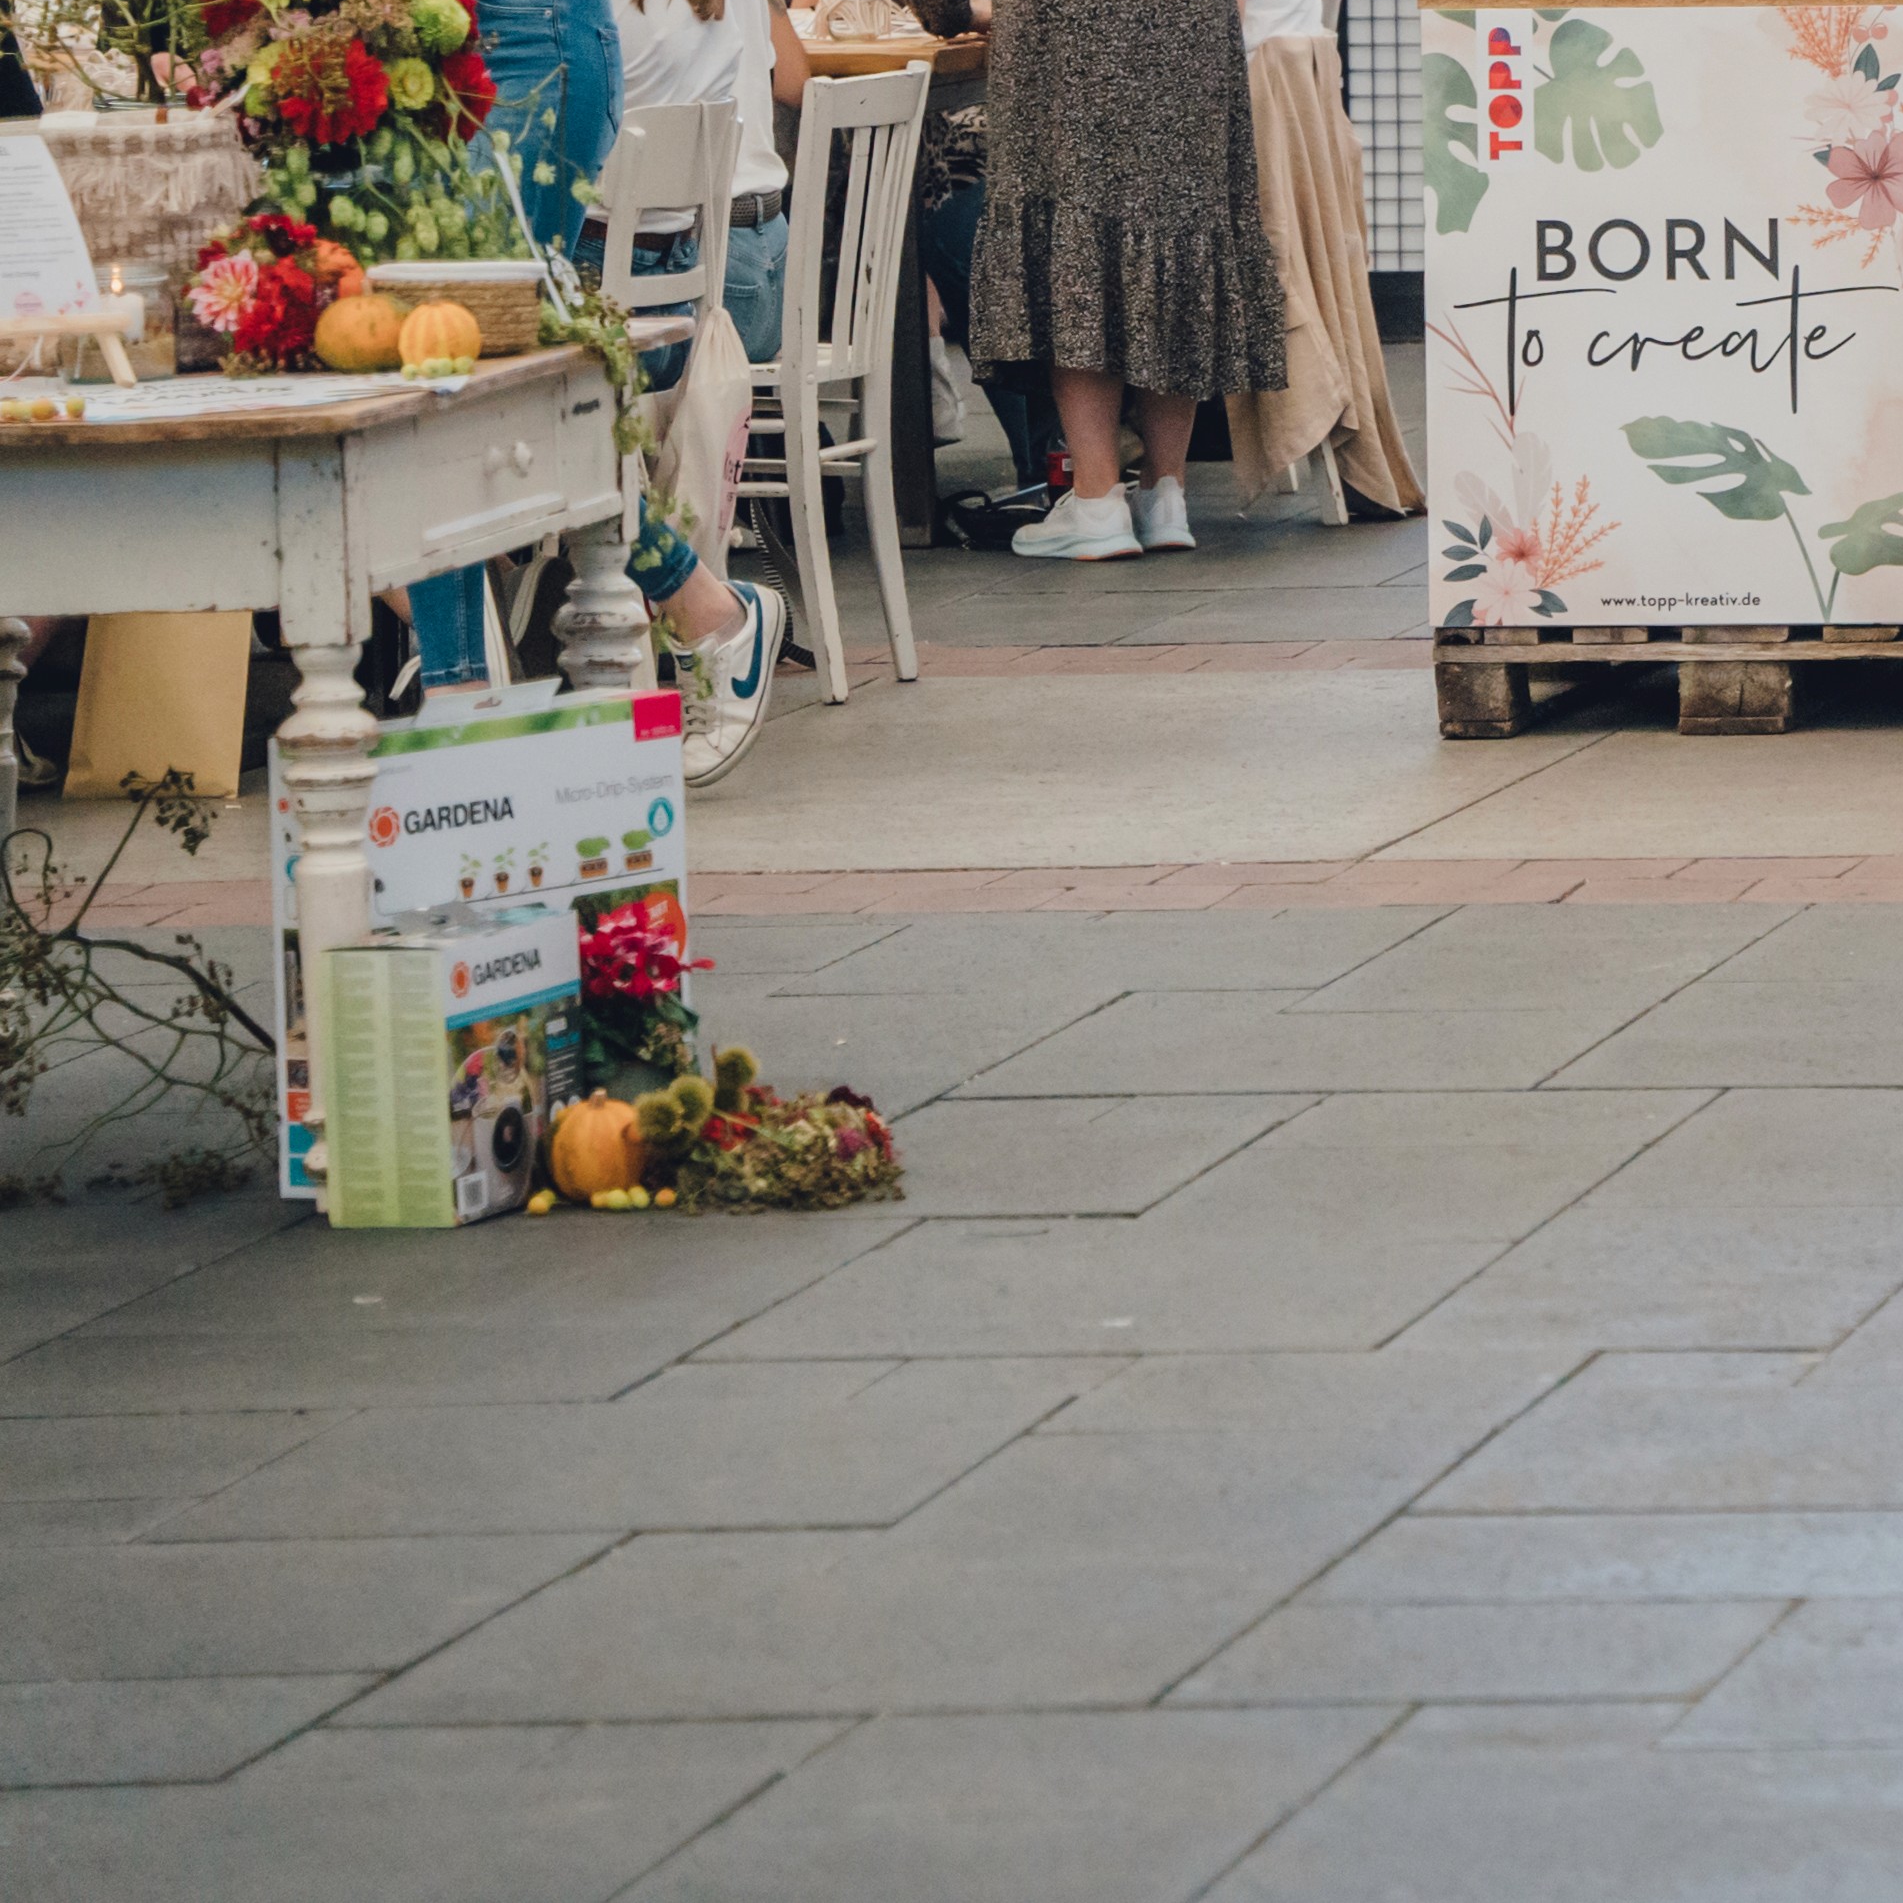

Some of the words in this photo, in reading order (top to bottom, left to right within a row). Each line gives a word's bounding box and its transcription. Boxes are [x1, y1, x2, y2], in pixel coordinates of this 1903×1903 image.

[1488, 26, 1525, 160] TOPP
[1534, 217, 1781, 283] BORN
[1453, 266, 1618, 417] to
[1586, 264, 1900, 415] create
[1600, 593, 1762, 611] www.topp-kreativ.de
[554, 774, 675, 806] Micro-Drip-System
[404, 796, 515, 836] GARDENA
[472, 947, 543, 987] GARDENA
